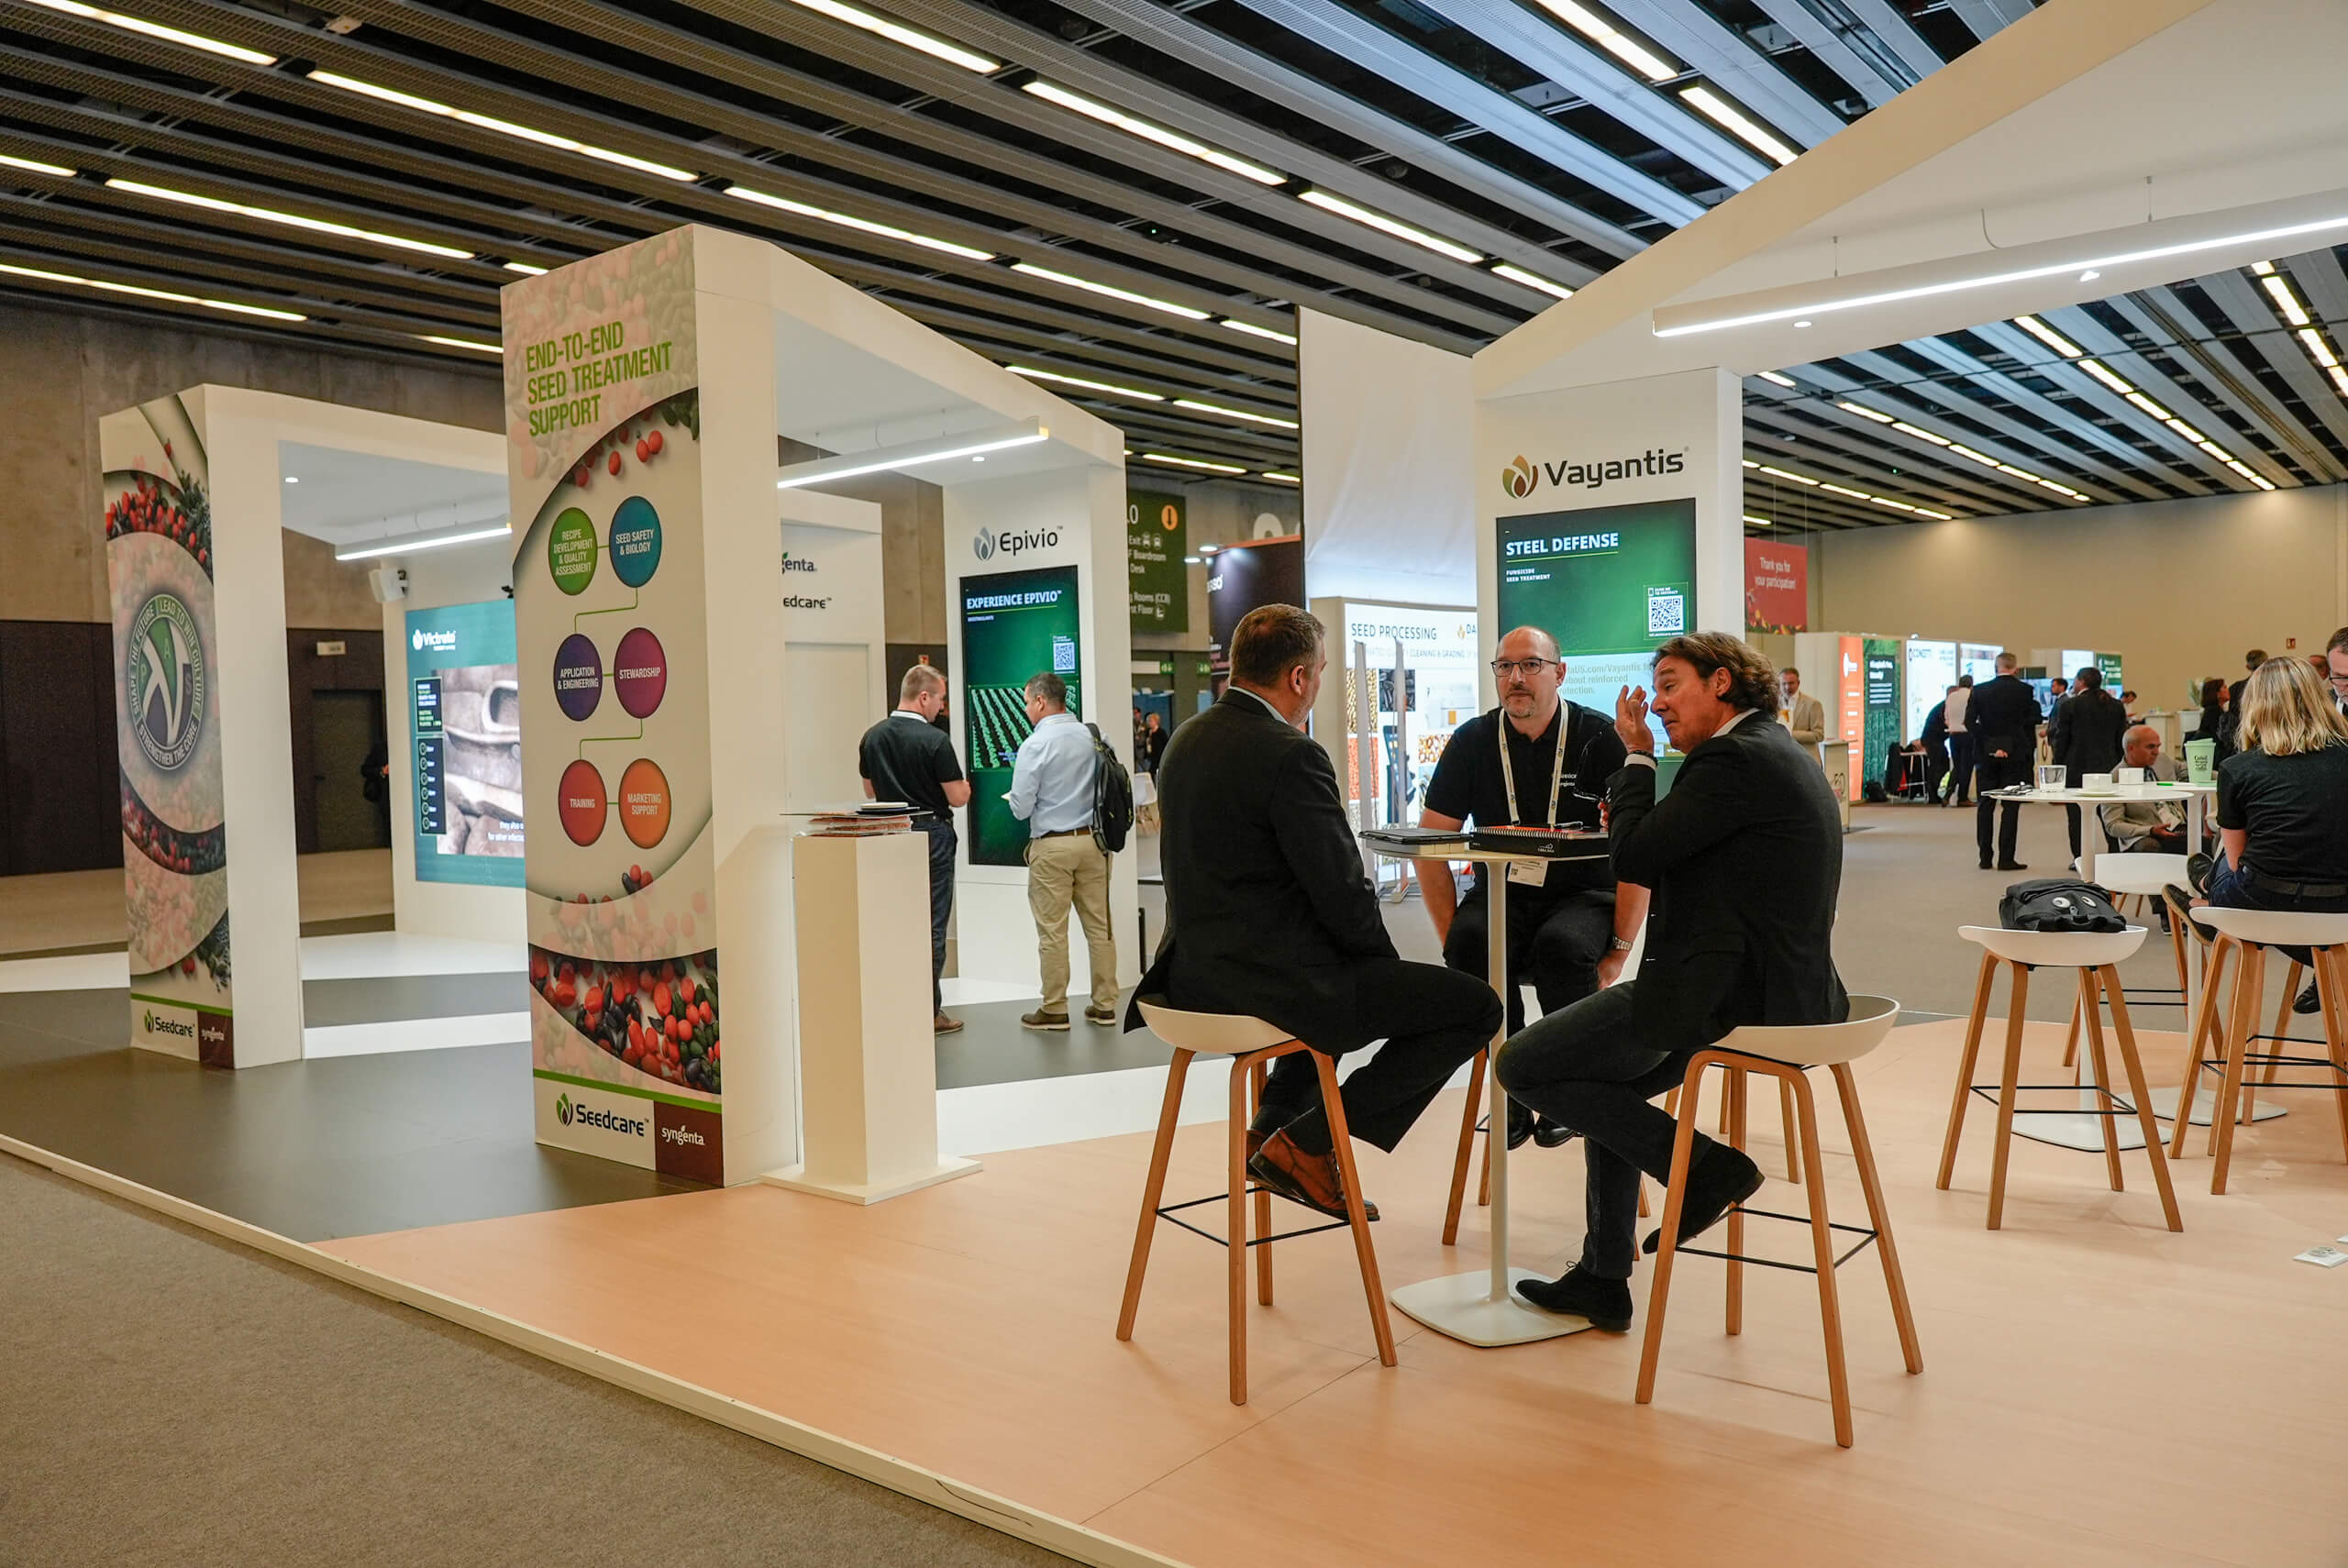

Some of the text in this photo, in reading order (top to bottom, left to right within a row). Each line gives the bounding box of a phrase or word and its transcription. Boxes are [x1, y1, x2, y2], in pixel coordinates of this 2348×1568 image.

[526, 321, 624, 373] END-TO-END
[527, 341, 672, 404] SEED TREATMENT
[529, 394, 602, 436] SUPPORT
[1545, 448, 1684, 489] Vayantis
[1127, 504, 1139, 524] 0
[562, 529, 581, 540] RECIPE
[615, 529, 654, 544] SEED SAFETY
[554, 538, 593, 554] DEVELOPMENT
[619, 542, 651, 556] & BIOLOGY
[1506, 533, 1619, 556] STEEL DEFENSE
[564, 551, 587, 564] QUALITY
[1134, 549, 1167, 561] Boardroom
[556, 562, 592, 576] ASSESSMENT
[782, 557, 815, 574] enta
[1130, 562, 1146, 574] Desk
[1759, 557, 1775, 570] Thank
[1775, 561, 1783, 573] you
[1755, 576, 1766, 588] your
[967, 593, 1023, 610] EXPERIENCE
[1134, 591, 1154, 602] Rooms
[1138, 603, 1154, 615] Floor
[1351, 623, 1437, 640] SEED PROCESSING
[160, 601, 176, 615] LEAD
[176, 607, 184, 624] TO
[193, 648, 202, 708] CULTURE
[164, 638, 172, 659] A
[130, 604, 155, 716] SHAPE THE FUTURE
[560, 667, 594, 679] APPLICATION
[619, 667, 660, 679] STEWARDSHIP
[1588, 674, 1628, 684] reinforced
[558, 678, 598, 690] & ENGINEERING
[139, 720, 198, 765] STRENGTHEN THE CORE
[570, 798, 595, 808] TRAINING
[627, 793, 661, 803] MARKETING
[631, 805, 659, 815] SUPPORT
[155, 1017, 194, 1038] Seedcare
[661, 1126, 705, 1145] syngenta
